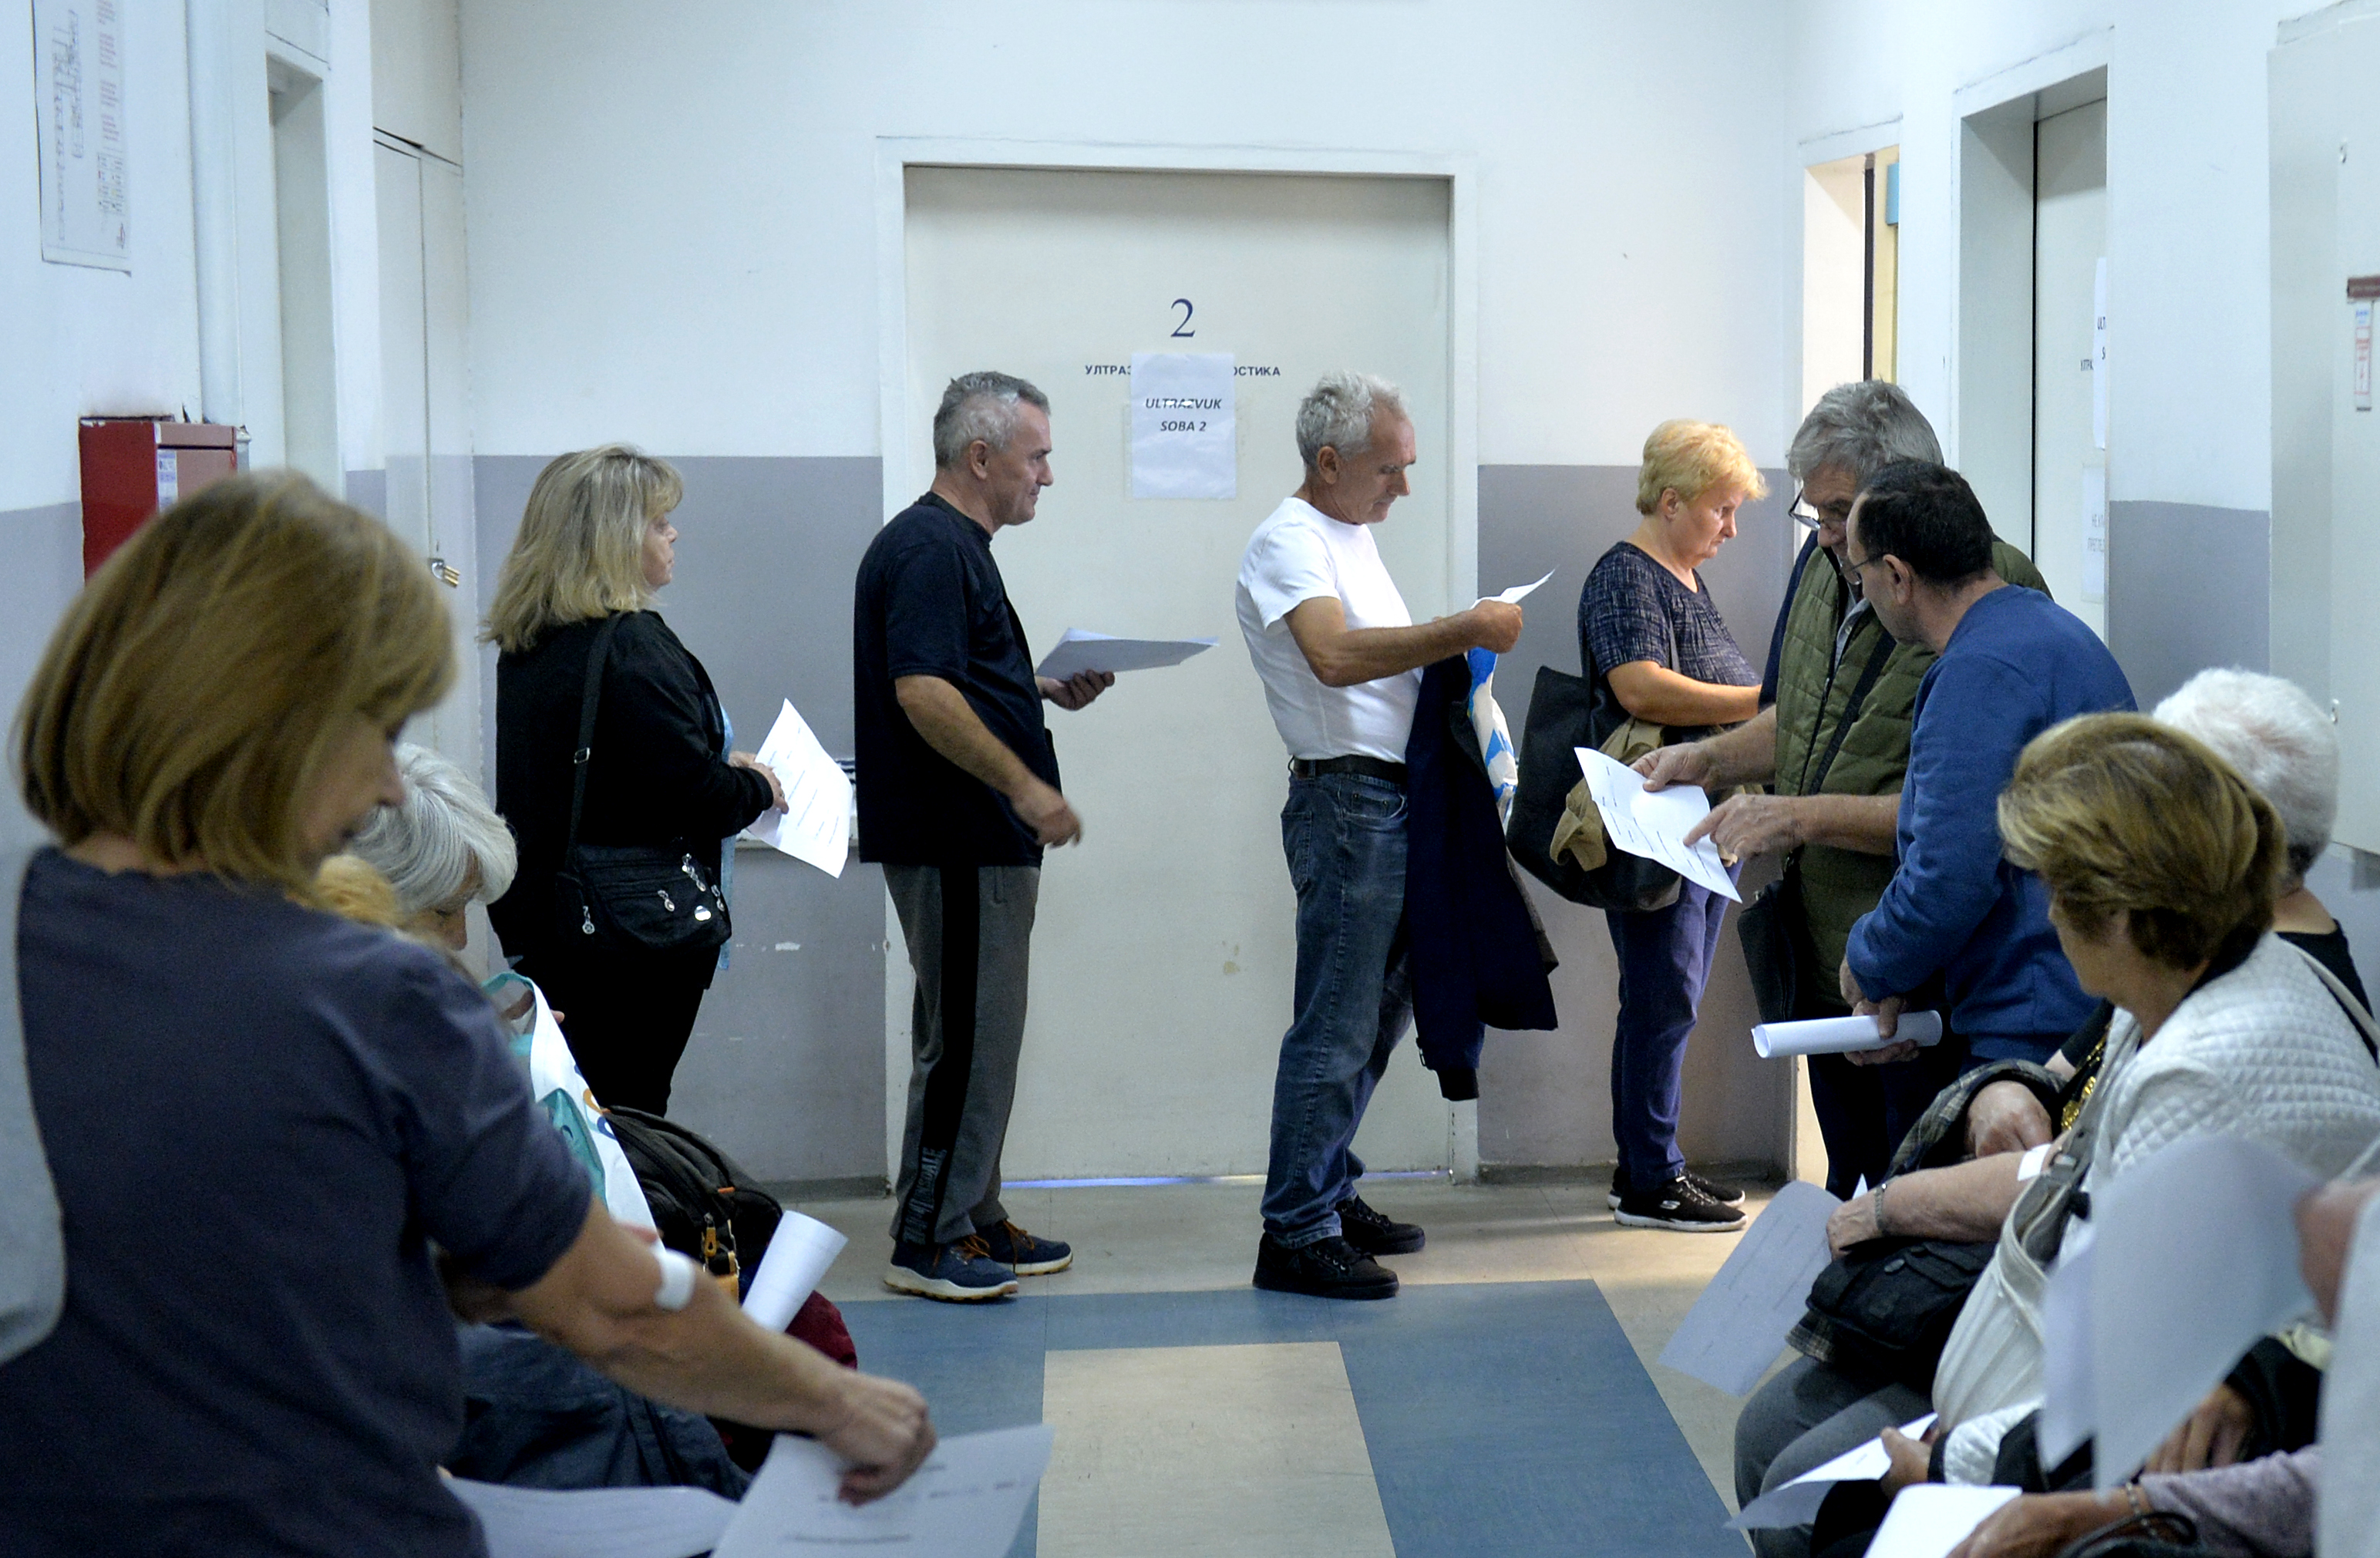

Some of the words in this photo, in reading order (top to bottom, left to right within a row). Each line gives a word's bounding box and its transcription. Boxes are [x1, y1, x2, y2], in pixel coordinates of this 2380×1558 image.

[1170, 298, 1196, 338] 2
[1145, 398, 1222, 409] ULTRAZVUK
[1160, 420, 1195, 432] SOBA
[1199, 421, 1207, 432] 2
